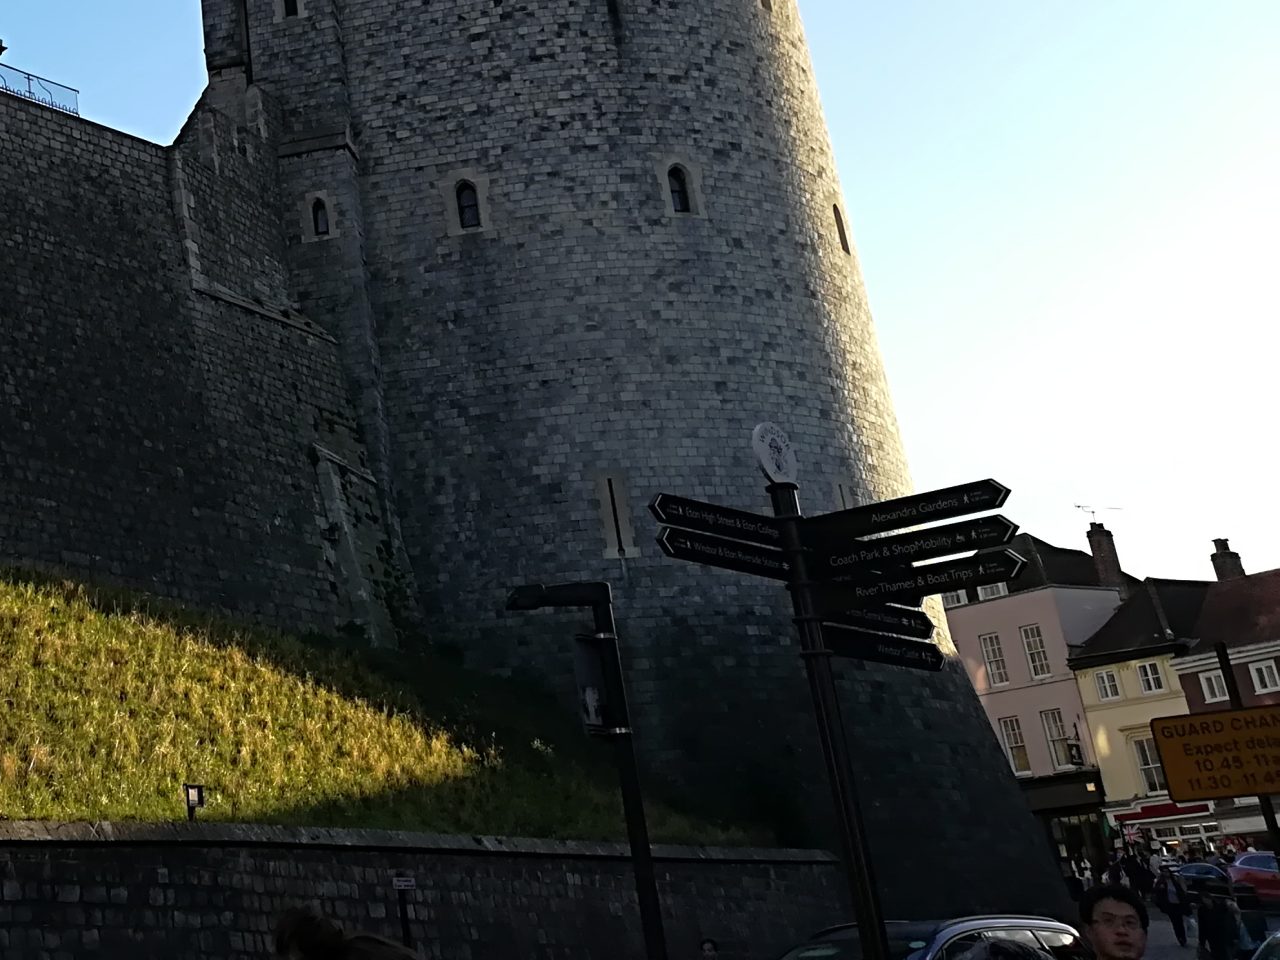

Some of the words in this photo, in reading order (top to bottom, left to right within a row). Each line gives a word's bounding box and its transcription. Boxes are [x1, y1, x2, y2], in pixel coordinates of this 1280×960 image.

[871, 506, 918, 524] Alexandra
[918, 497, 959, 513] Gardens
[829, 552, 858, 568] Coach
[859, 547, 881, 562] Park
[882, 547, 891, 557] &
[891, 534, 953, 556] ShopMobility
[855, 583, 880, 598] River
[879, 578, 916, 595] Thames
[916, 576, 926, 587] &
[926, 572, 950, 586] Boat
[949, 567, 975, 583] Trips
[1160, 719, 1225, 739] GUARD
[1183, 739, 1241, 757] Expect
